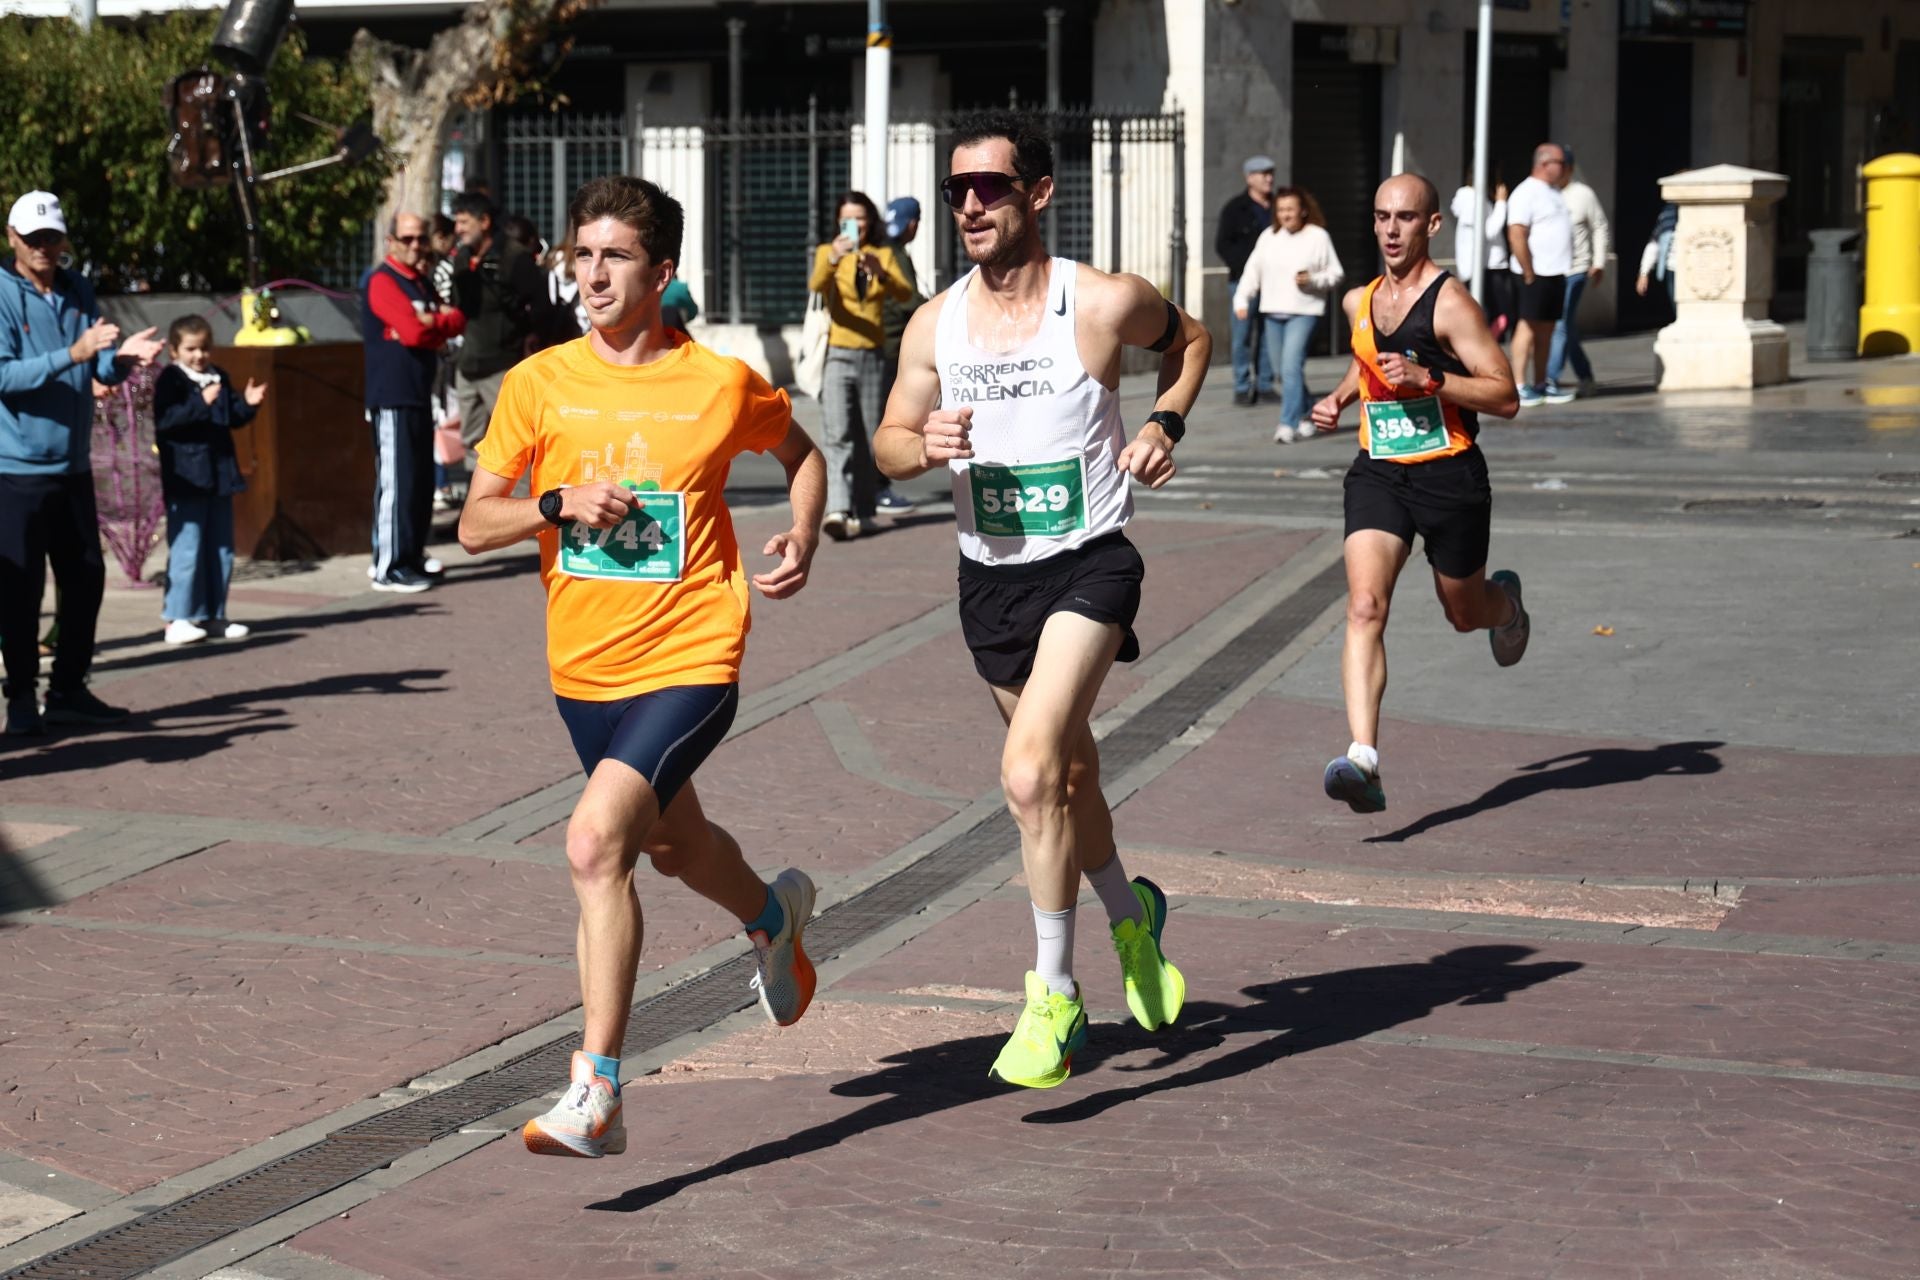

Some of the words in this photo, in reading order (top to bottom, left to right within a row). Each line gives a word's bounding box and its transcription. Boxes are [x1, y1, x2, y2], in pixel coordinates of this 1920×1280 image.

[949, 357, 1054, 382] CORRIENDO
[951, 380, 1055, 402] PALENCIA
[1375, 416, 1431, 439] 3593
[982, 484, 1069, 514] 5529
[570, 520, 664, 550] 4744
